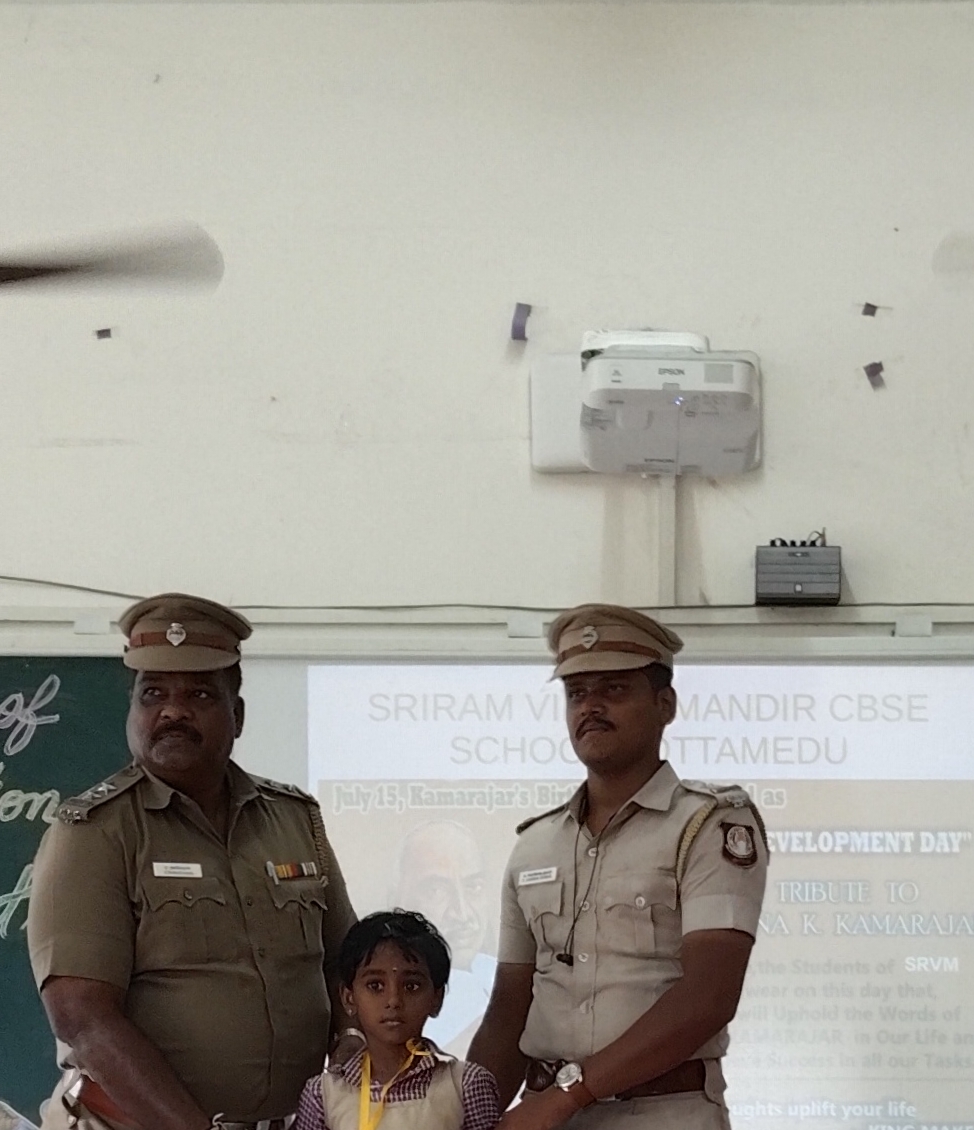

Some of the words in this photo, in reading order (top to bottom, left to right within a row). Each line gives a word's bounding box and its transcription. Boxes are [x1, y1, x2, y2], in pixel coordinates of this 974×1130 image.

[658, 367, 685, 376] EPSON
[368, 693, 512, 721] SRIRAM
[677, 693, 817, 721] MANDIR
[829, 693, 930, 722] CBSE
[450, 736, 579, 764] SCHOO
[334, 784, 371, 815] July
[375, 784, 403, 814] 15,
[407, 783, 530, 814] Kamarajar's
[767, 831, 914, 853] EVELOPMENT
[777, 881, 869, 902] TRIBUTE
[887, 881, 919, 902] TO
[836, 914, 974, 935] KAMARAJA
[791, 958, 870, 975] Students
[876, 958, 896, 975] of
[905, 956, 960, 972] SRVM
[745, 986, 789, 998] wear
[793, 986, 817, 998] on
[822, 982, 855, 998] this
[773, 1004, 839, 1026] Uphold
[844, 1005, 873, 1021] the
[878, 1004, 937, 1022] Words
[942, 1004, 962, 1022] of
[876, 1029, 911, 1045] Our
[953, 1033, 974, 1045] an
[788, 1101, 837, 1120] uplift
[841, 1105, 883, 1120] your
[887, 1101, 917, 1117] life
